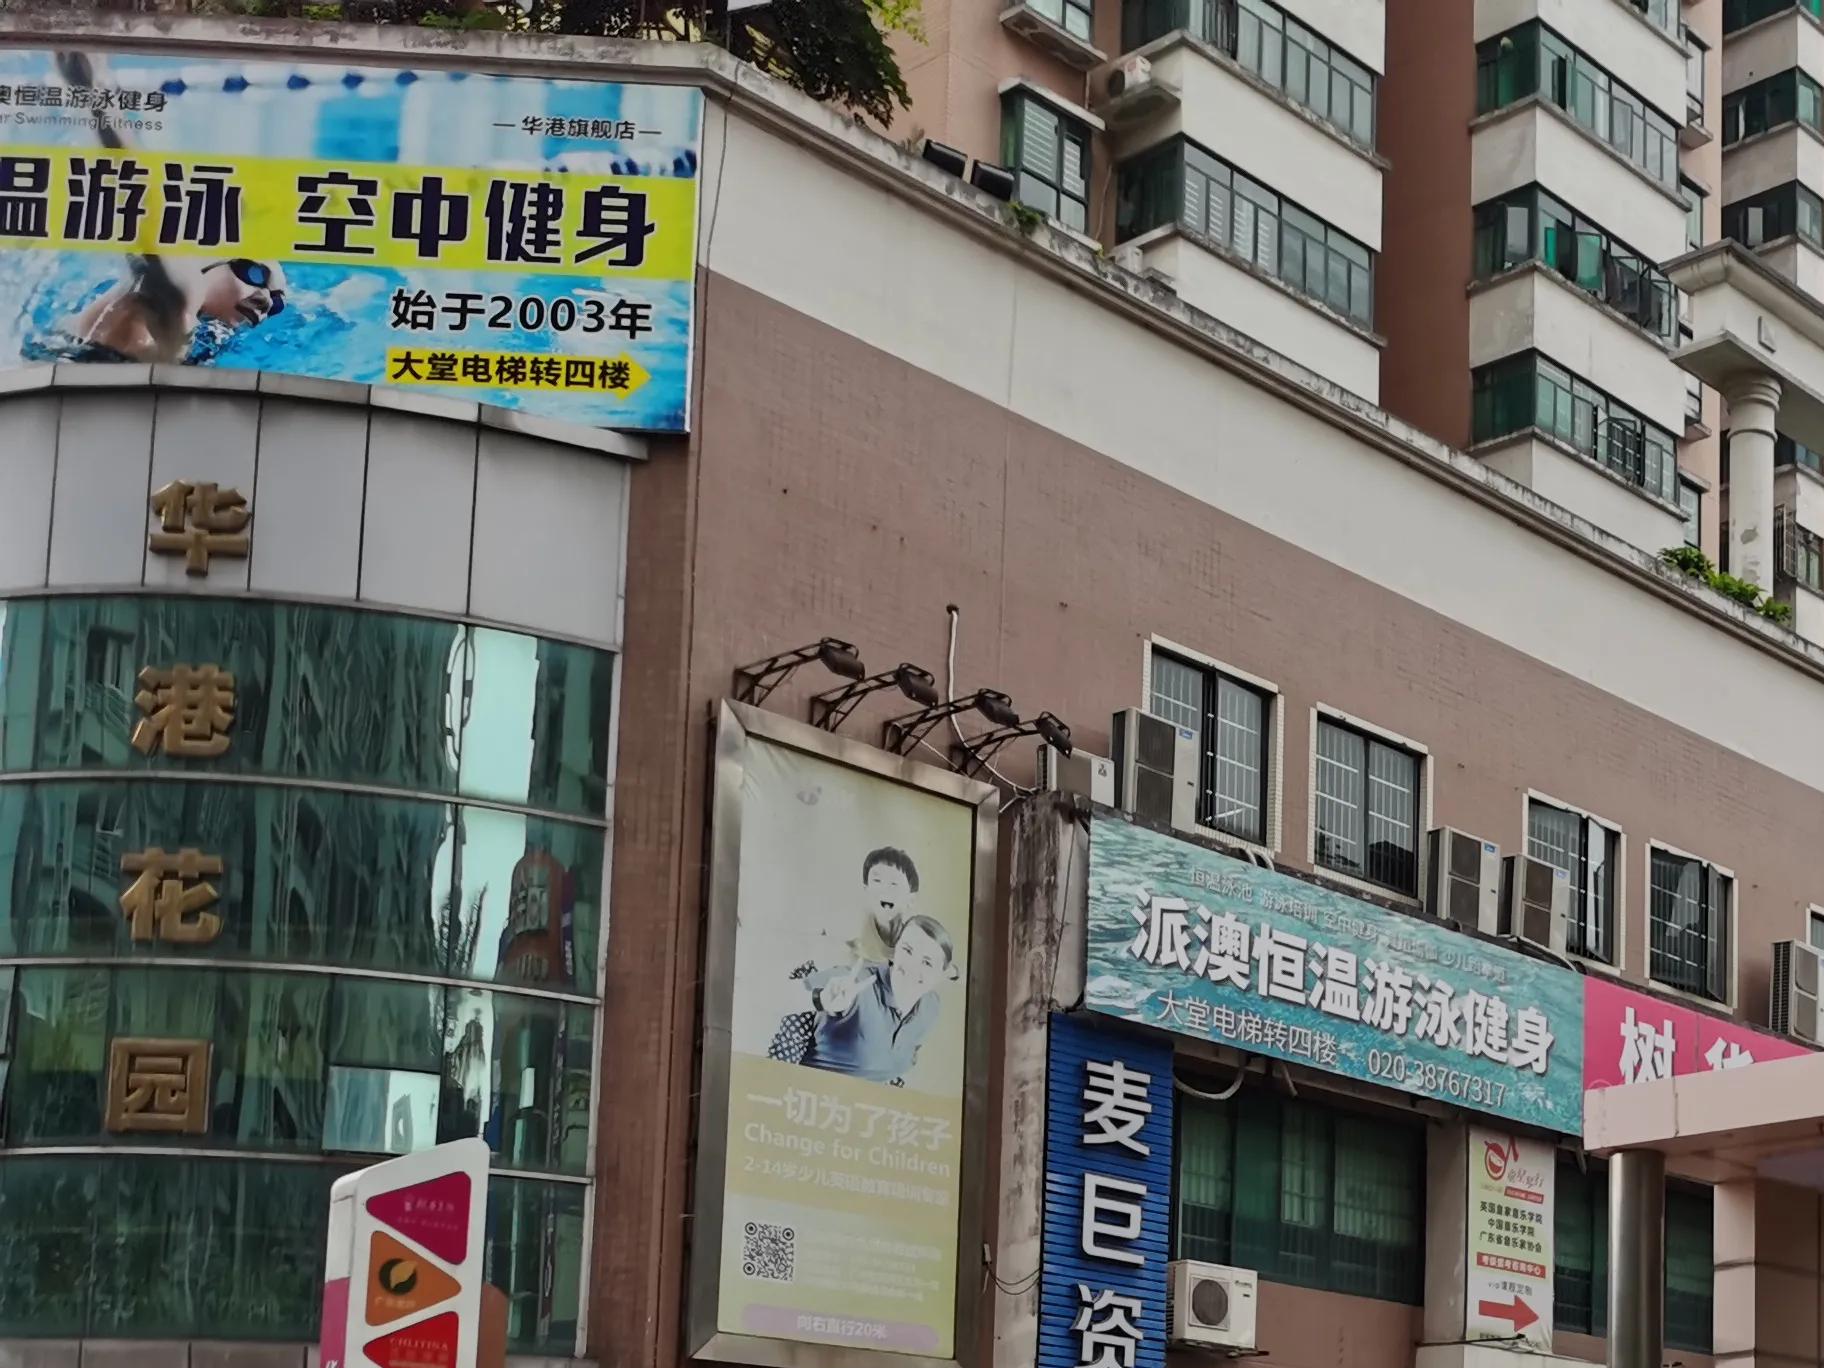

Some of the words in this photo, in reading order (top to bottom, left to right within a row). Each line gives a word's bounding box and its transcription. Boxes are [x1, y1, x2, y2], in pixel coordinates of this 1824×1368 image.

[14, 111, 99, 130] Swimming
[103, 116, 164, 131] Fitness
[520, 115, 636, 141] 华港旗舰店
[293, 171, 656, 268] 空中健身
[390, 289, 653, 340] 始于2003年
[390, 350, 631, 392] 大堂电梯转四楼
[1128, 889, 1556, 1077] 派澳恒温游泳健身
[1156, 989, 1339, 1067] 大堂电梯转四楼
[1367, 1047, 1507, 1108] 020-38767317
[746, 1087, 953, 1152] 一切为了孩子
[744, 1123, 827, 1158] Change
[832, 1139, 862, 1161] for
[867, 1147, 950, 1178] Children
